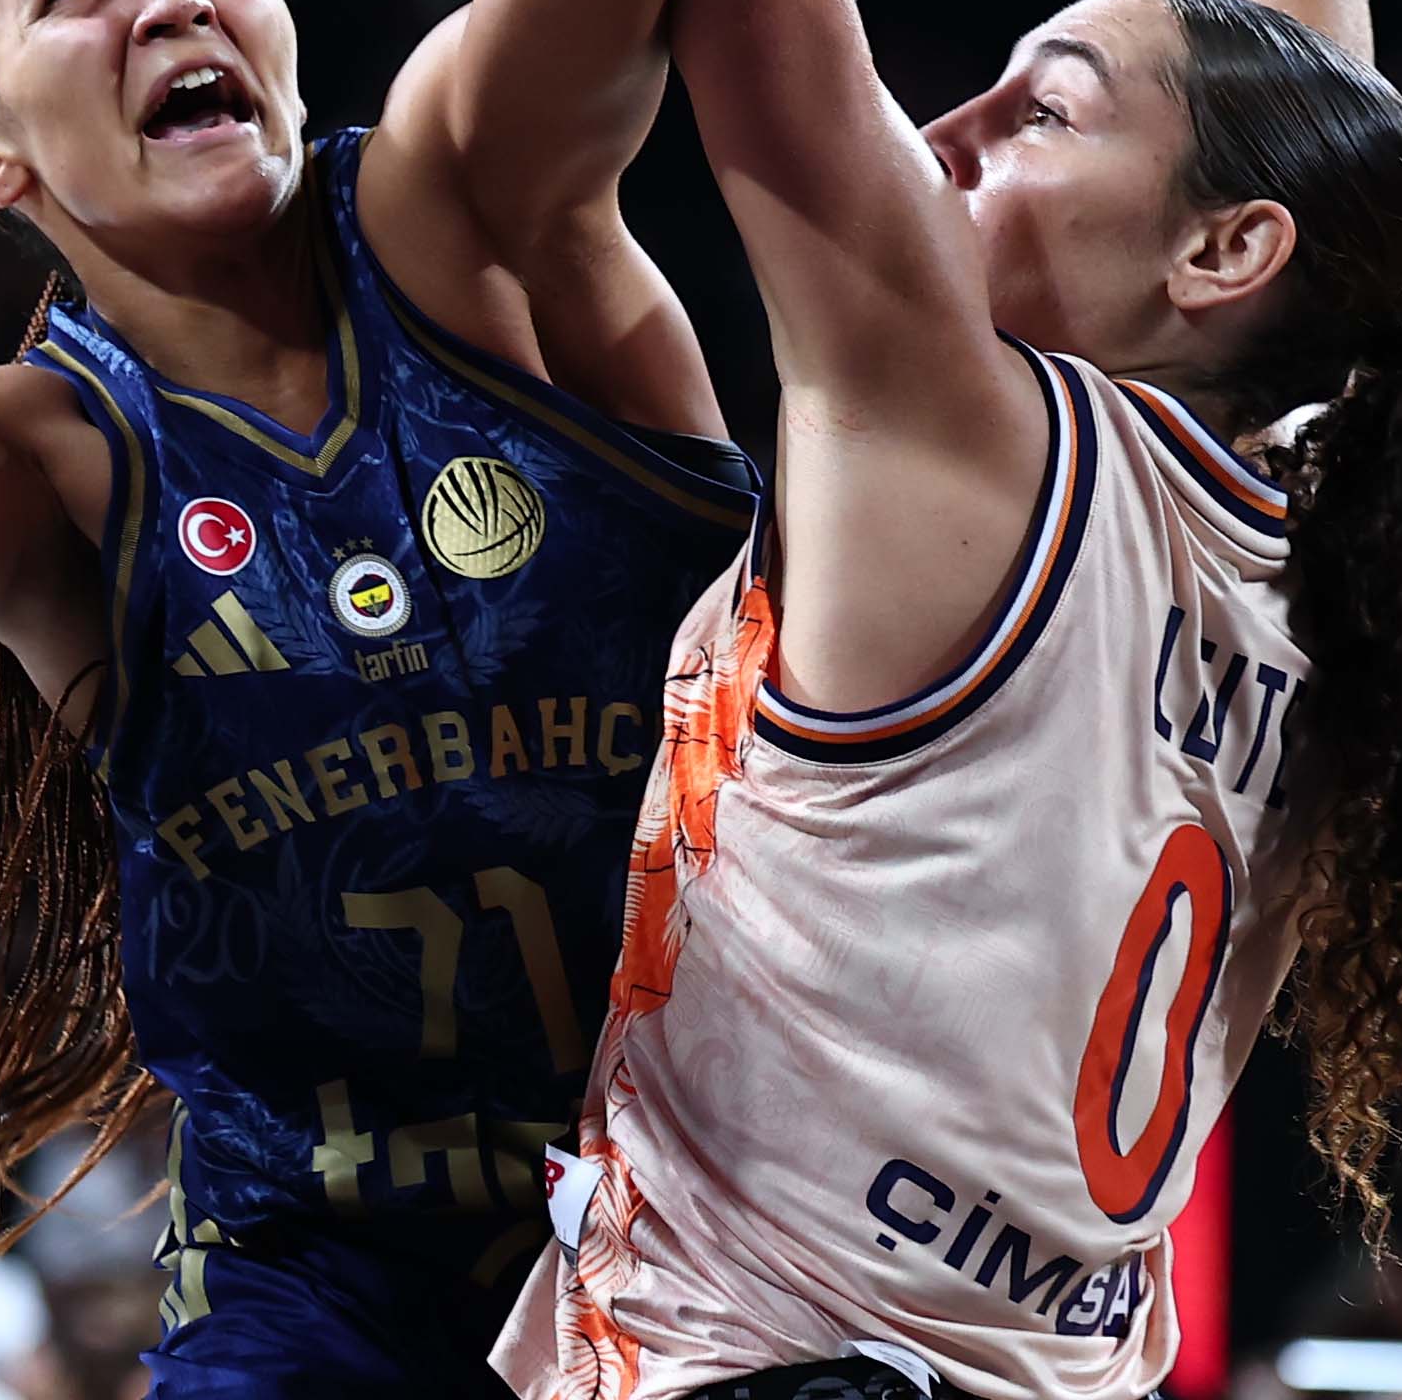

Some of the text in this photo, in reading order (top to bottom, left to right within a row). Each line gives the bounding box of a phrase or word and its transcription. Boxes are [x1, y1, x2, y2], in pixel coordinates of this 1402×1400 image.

[355, 640, 429, 683] tarfin
[156, 696, 663, 881] FENERBAHÇ
[340, 865, 590, 1075] 71
[1073, 823, 1233, 1225] 0
